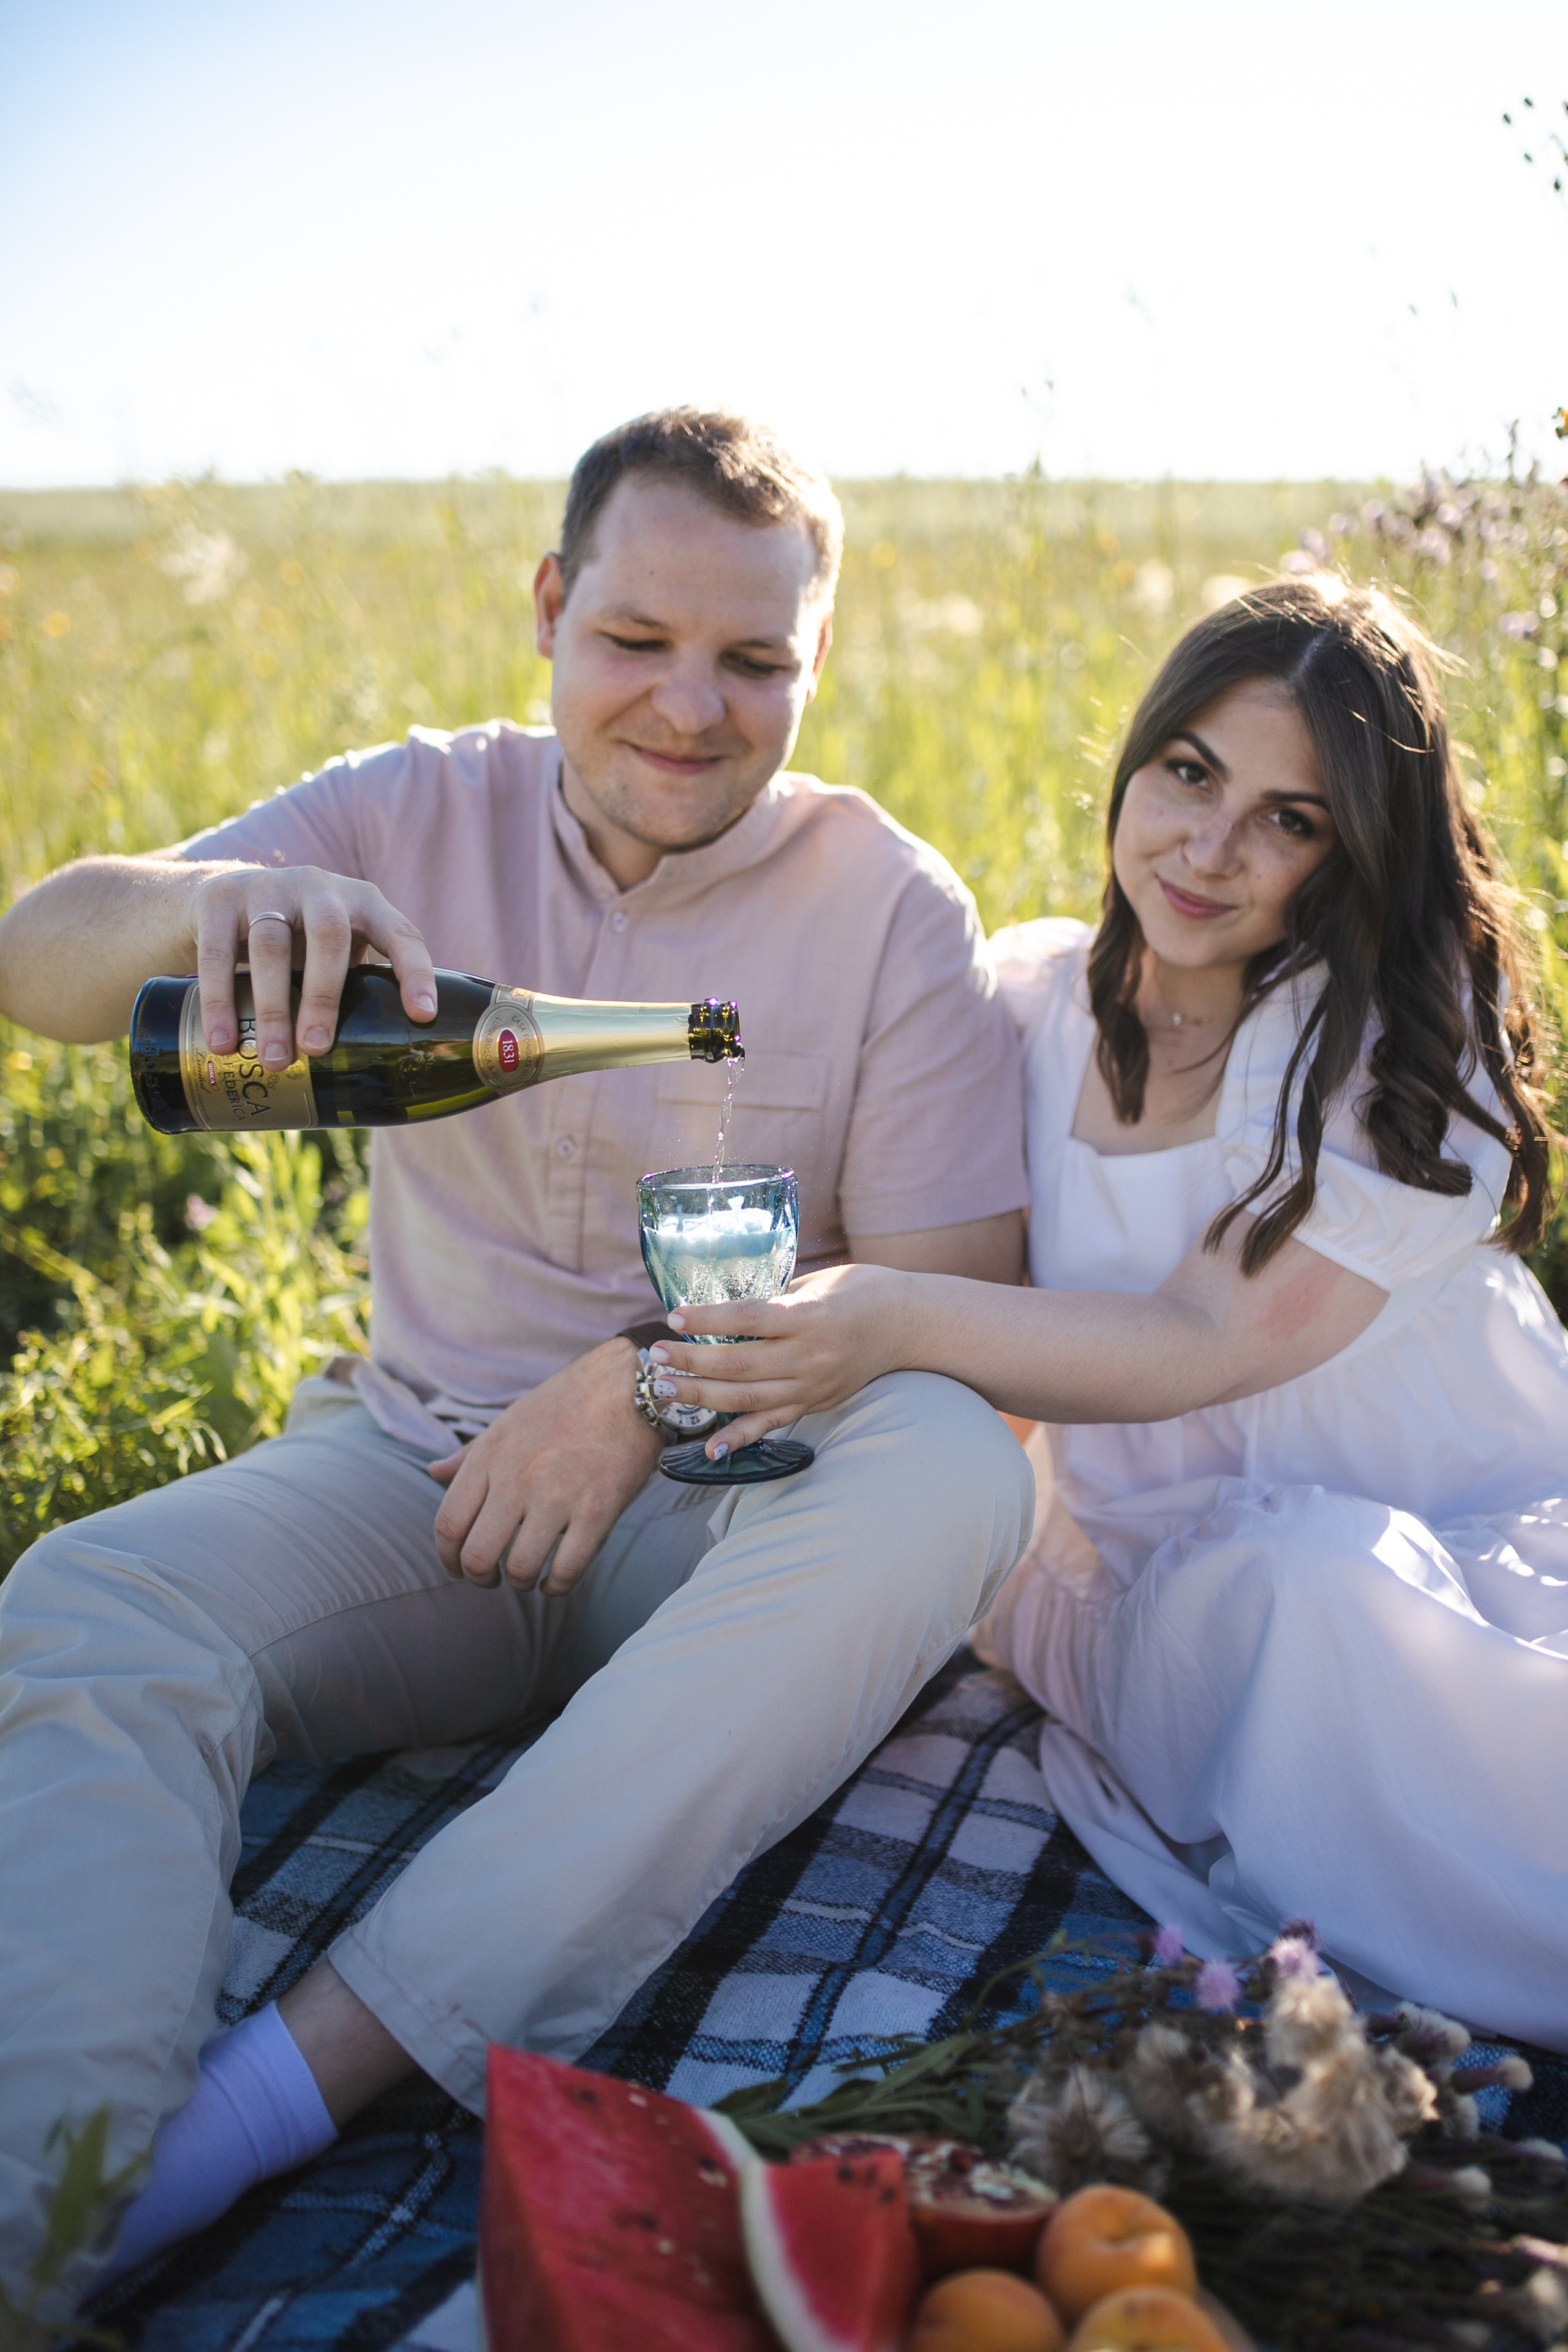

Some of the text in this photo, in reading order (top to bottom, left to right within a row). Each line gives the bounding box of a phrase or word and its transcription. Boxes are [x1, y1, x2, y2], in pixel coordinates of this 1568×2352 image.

[488, 1017, 502, 1037] LUIGI
[502, 1039, 515, 1063] 1831
[511, 1016, 532, 1080] CASA FONDATA NEL
[195, 1047, 211, 1095] Limited
[223, 1063, 247, 1121] FEDERICA
